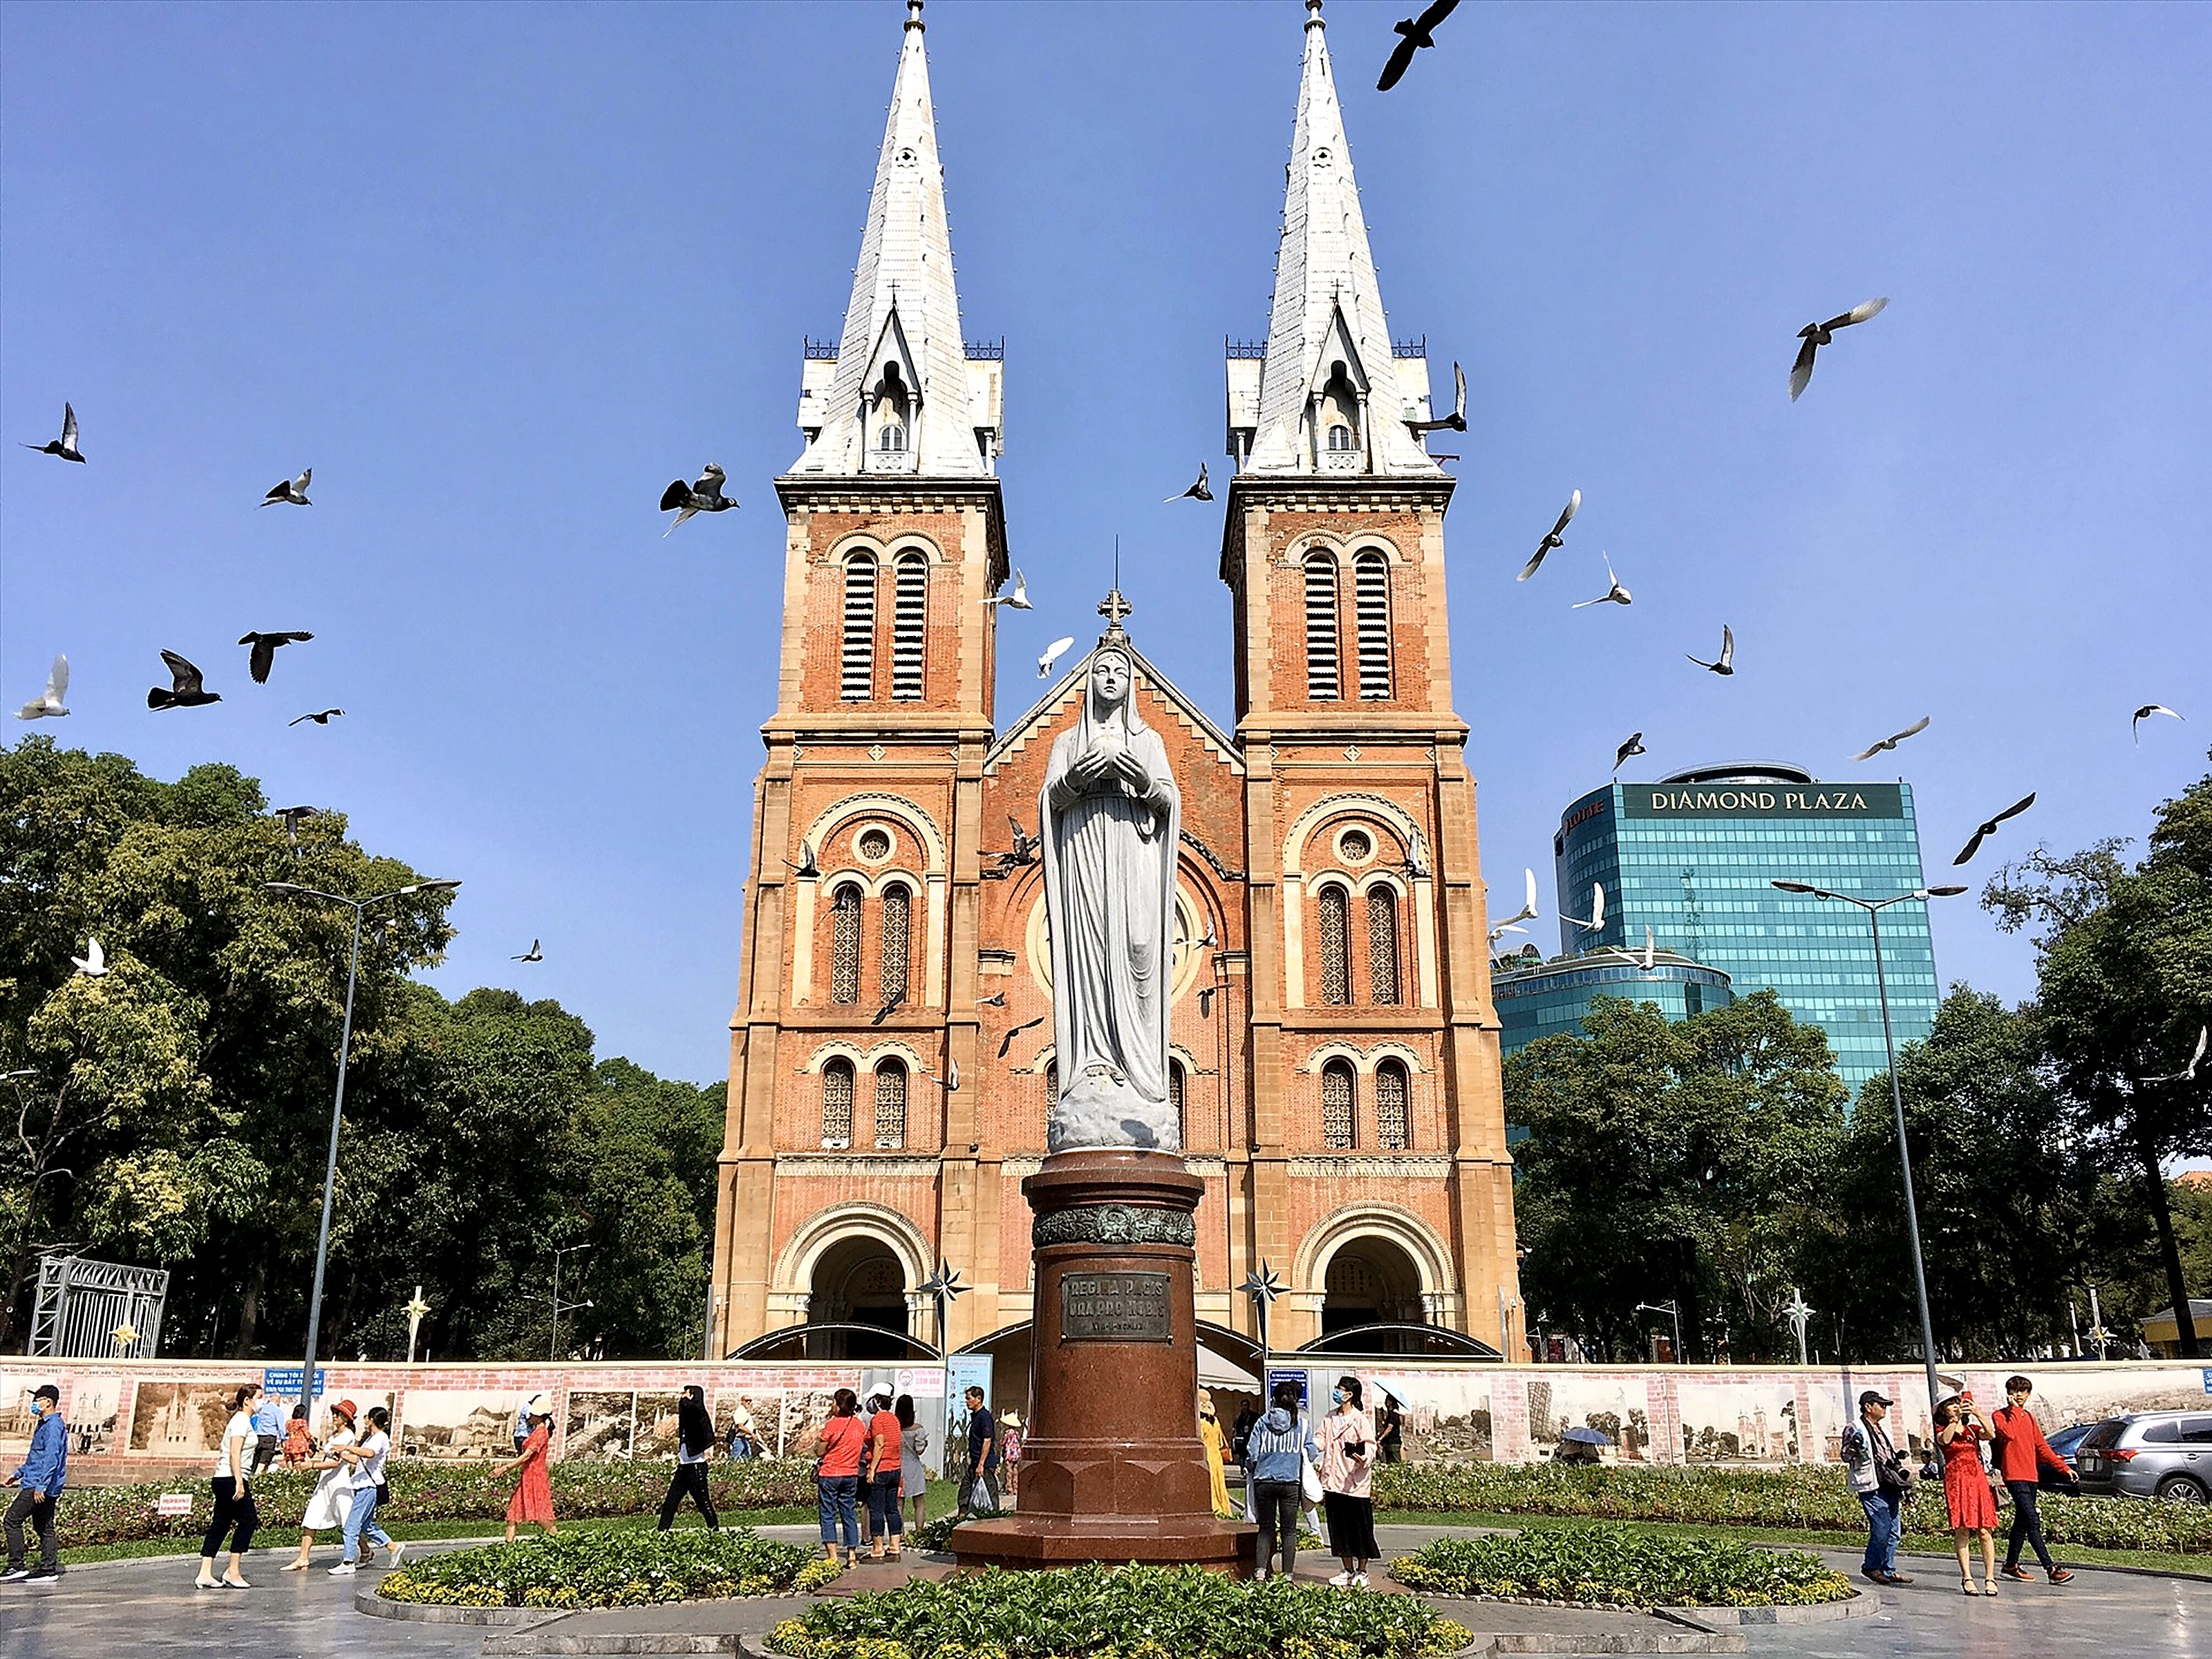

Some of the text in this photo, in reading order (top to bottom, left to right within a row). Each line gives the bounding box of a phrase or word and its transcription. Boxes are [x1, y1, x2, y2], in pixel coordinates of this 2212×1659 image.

[1651, 791, 1868, 809] DIAMOND PLAZA
[1071, 1280, 1163, 1296] REGINA PACIS
[1069, 1300, 1164, 1317] ORA PRO NOBIS
